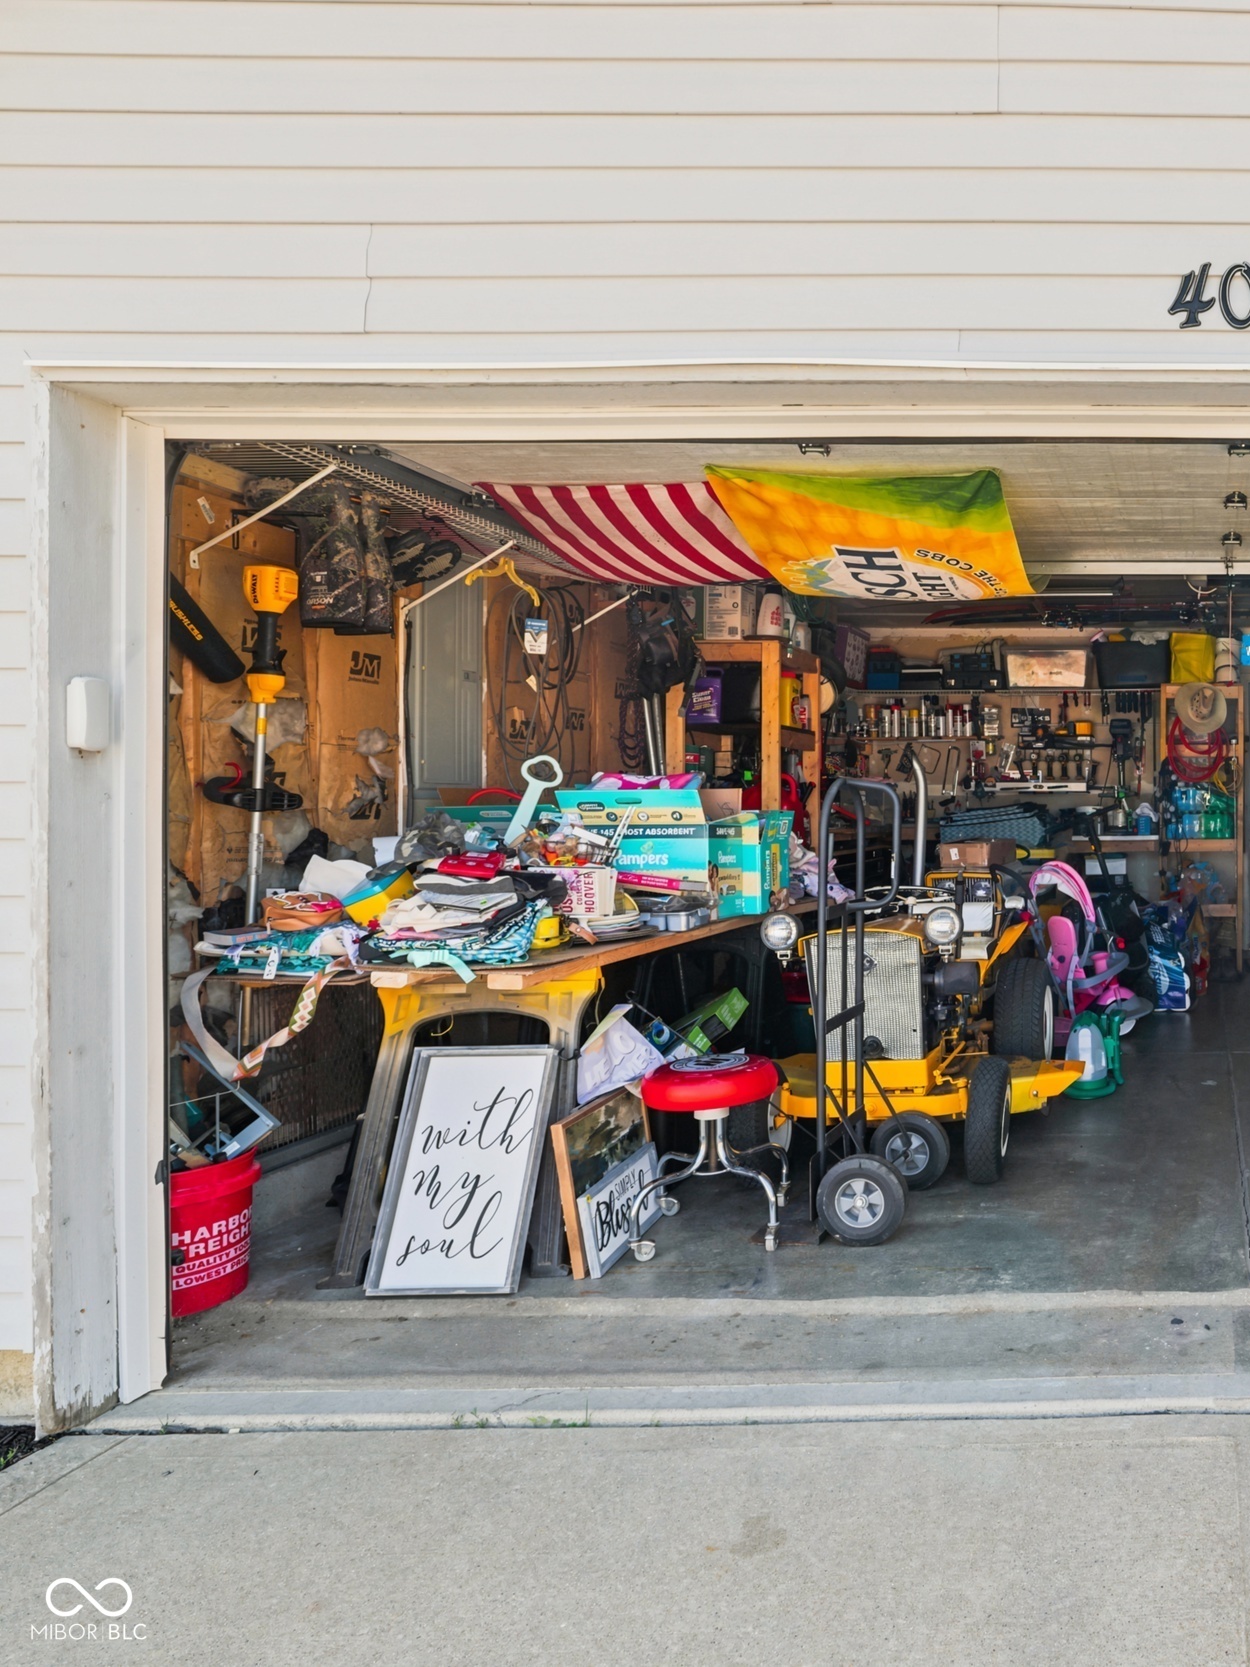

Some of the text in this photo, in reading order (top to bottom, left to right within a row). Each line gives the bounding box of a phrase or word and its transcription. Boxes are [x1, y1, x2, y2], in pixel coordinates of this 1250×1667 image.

[915, 549, 973, 571] COBS
[349, 651, 381, 679] JM
[646, 828, 696, 836] ABSORBENT
[585, 872, 596, 913] HOOVER
[422, 1086, 534, 1155] with
[413, 1164, 495, 1230] my
[396, 1191, 504, 1266] soul
[175, 1247, 231, 1274] QUALITY
[175, 1265, 228, 1288] LOWEST
